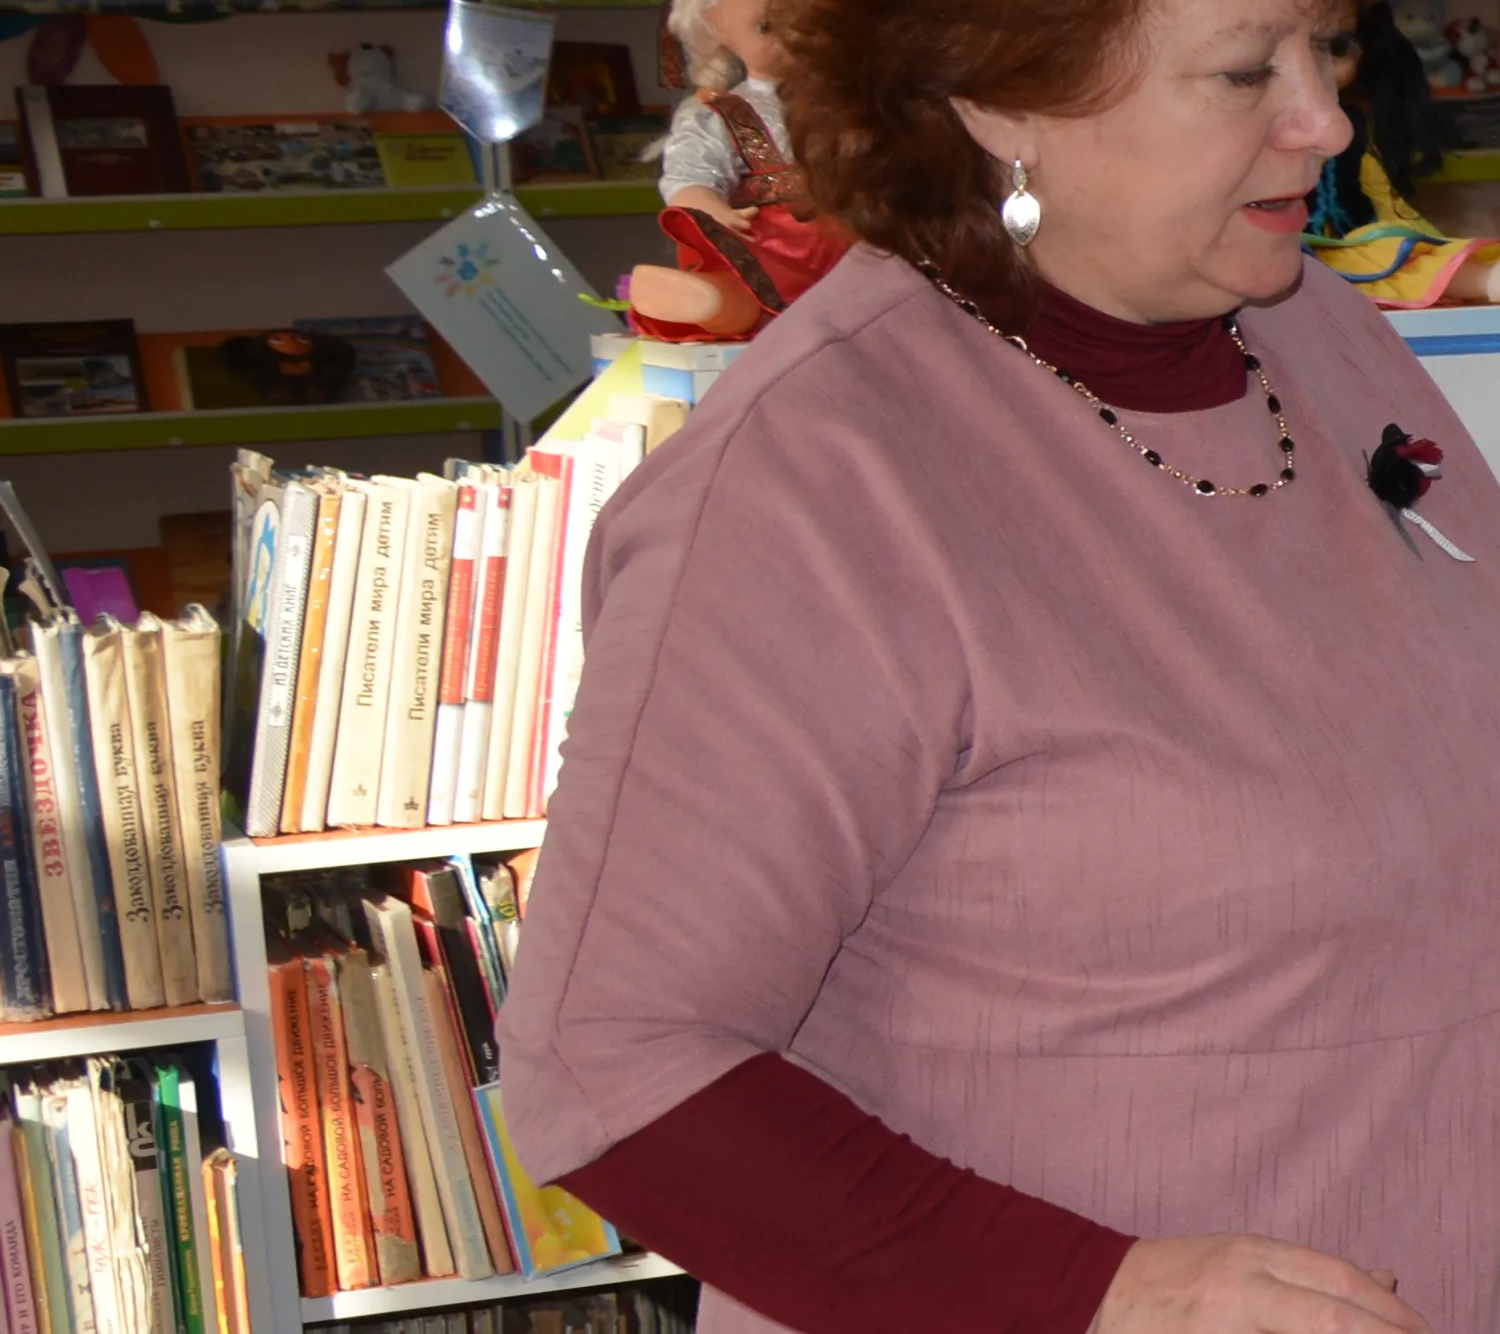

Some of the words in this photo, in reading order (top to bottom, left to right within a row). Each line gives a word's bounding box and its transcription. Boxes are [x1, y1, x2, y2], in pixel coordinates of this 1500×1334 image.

[374, 500, 394, 559] детям
[423, 512, 442, 571] детям
[280, 581, 298, 614] КНИГ
[368, 566, 389, 612] мира
[419, 578, 438, 626] мира
[275, 617, 296, 670] ДЕТСКИХ
[356, 619, 382, 708] Писатели
[273, 673, 288, 686] ИЗ
[408, 633, 433, 721] Писатели
[108, 722, 134, 777] буква
[145, 720, 167, 775] буква
[190, 719, 210, 773] буква
[117, 785, 151, 923] Заколдованная
[154, 782, 183, 921] Заколдованная
[195, 780, 224, 914] Заколдованная
[285, 988, 305, 1056] ДВИЖЕНИЕ
[316, 981, 336, 1049] ДВИЖЕНИЕ
[292, 1058, 310, 1119] БОЛЬШОЕ
[324, 1052, 343, 1112] БОЛЬШОЕ
[372, 1071, 387, 1109] БОЛЬ
[298, 1123, 318, 1187] САДОВОЙ
[331, 1116, 351, 1179] САДОВОЙ
[374, 1113, 394, 1176] САДОВОЙ
[307, 1188, 320, 1209] НА
[341, 1182, 354, 1202] НА
[382, 1177, 396, 1198] НА
[6, 1219, 25, 1278] КОМАНДА
[13, 1282, 26, 1304] ЕГО
[19, 1309, 29, 1318] И
